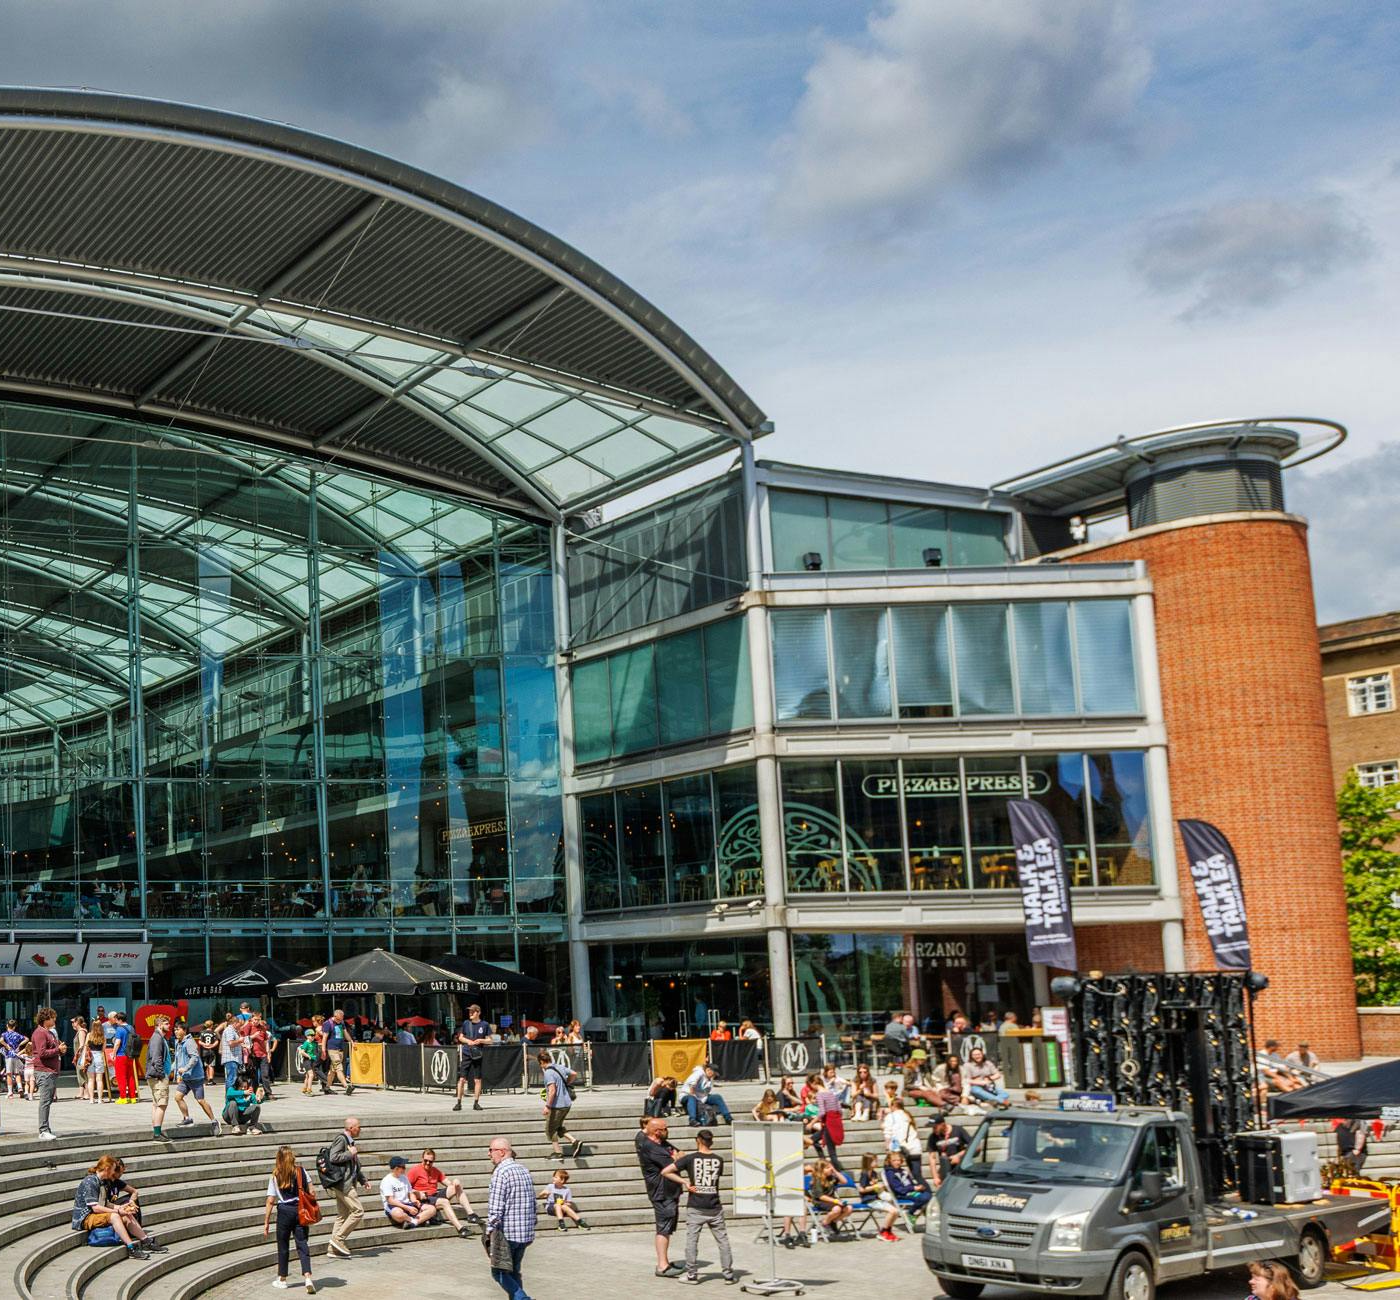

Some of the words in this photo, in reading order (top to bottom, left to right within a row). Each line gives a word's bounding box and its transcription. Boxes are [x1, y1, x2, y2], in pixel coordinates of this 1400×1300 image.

[1020, 863, 1043, 926] WALK
[1038, 868, 1064, 929] TALK
[1194, 877, 1225, 936] WALK
[1214, 881, 1244, 937] TALK
[893, 942, 967, 957] MARZANO
[931, 959, 938, 968] &
[945, 958, 967, 967] BAR
[322, 982, 369, 992] MARZANO
[430, 981, 448, 991] CAFE
[457, 982, 469, 992] BAR
[480, 982, 508, 991] RZANO
[205, 1036, 211, 1044] 8
